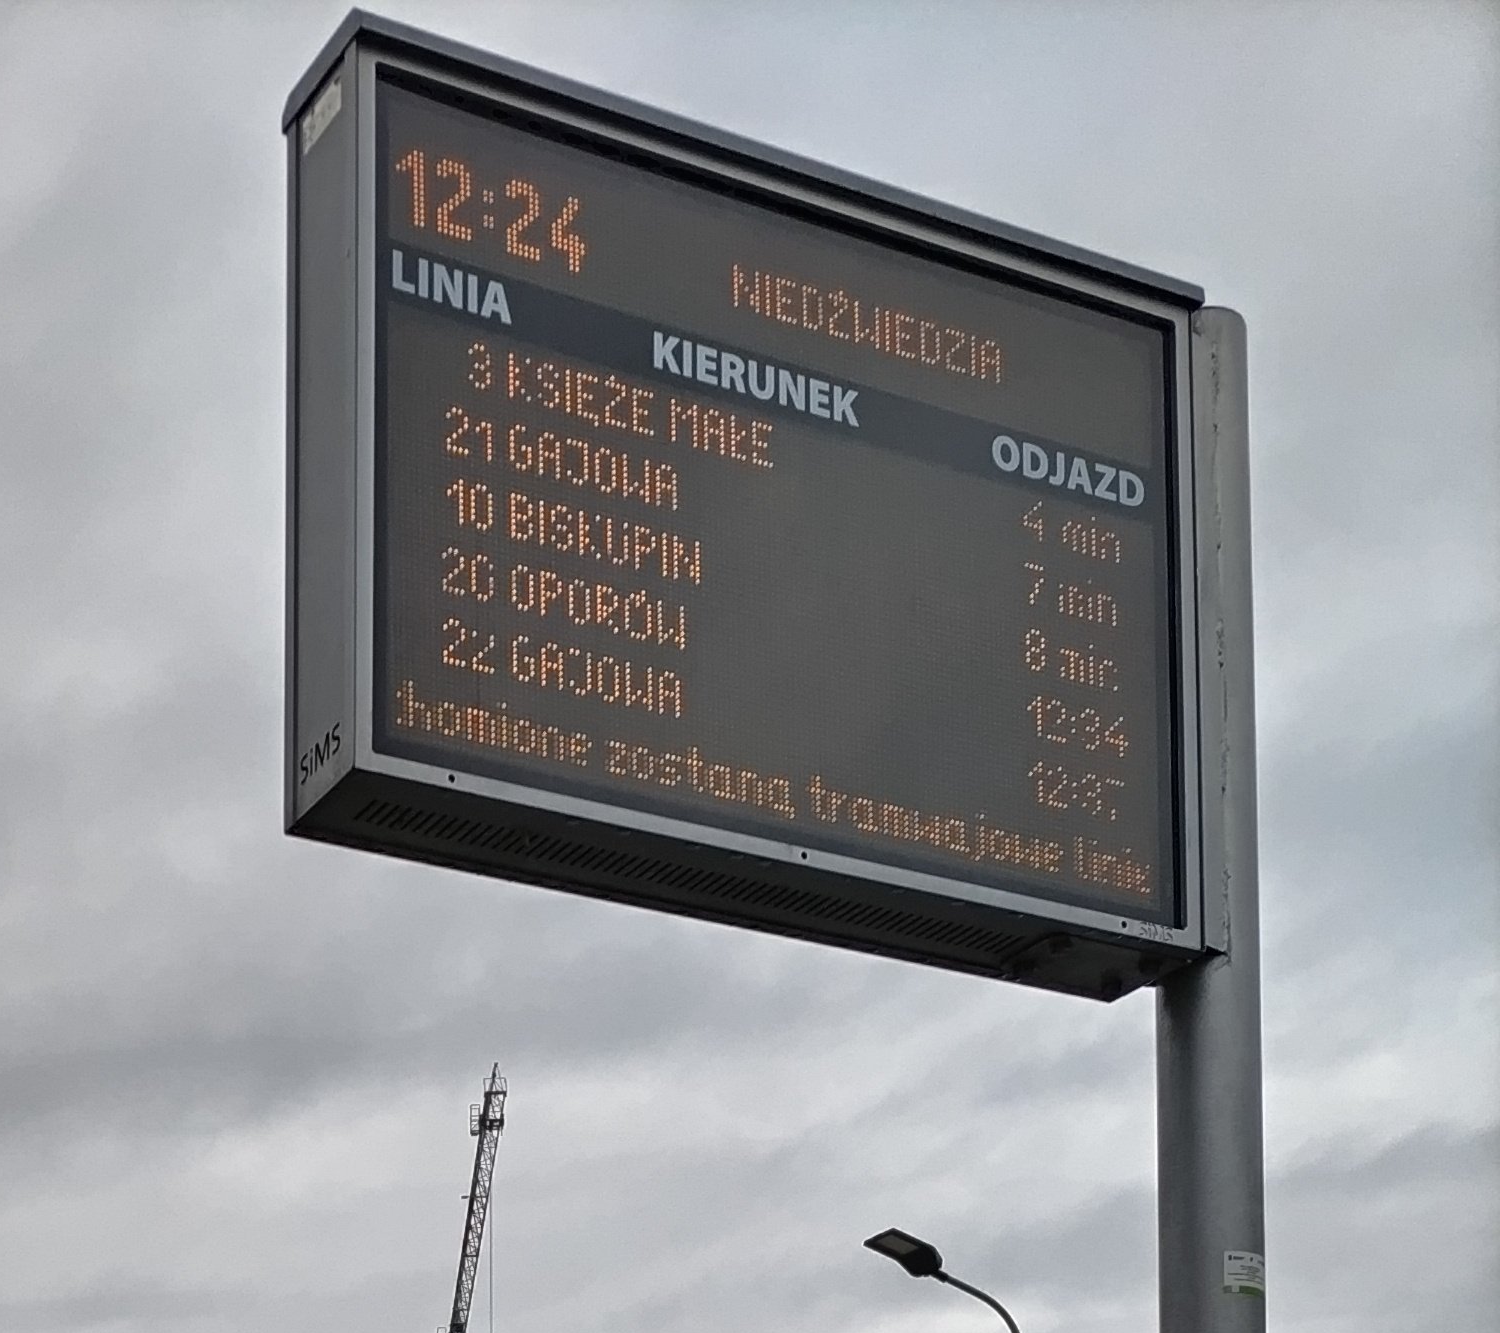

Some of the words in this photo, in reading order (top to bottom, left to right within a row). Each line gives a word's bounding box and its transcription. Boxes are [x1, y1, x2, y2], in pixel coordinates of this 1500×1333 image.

[396, 150, 586, 273] 12:24
[392, 249, 512, 325] LINIA
[468, 342, 491, 390] 3
[653, 330, 860, 428] KIERUNEK
[445, 406, 493, 463] 21
[508, 424, 678, 511] GAJOWA
[992, 435, 1145, 507] ODJAZD
[446, 478, 493, 531] 10
[510, 492, 700, 585] BISKUPIN
[1022, 501, 1044, 541] 4
[1062, 515, 1121, 563] min
[442, 546, 494, 602] 20
[511, 563, 685, 650] OPORÓW
[1024, 562, 1044, 605] 7
[442, 618, 495, 674] 22
[512, 635, 681, 718] GAJOWA
[1025, 629, 1046, 671] 8
[396, 680, 593, 767] homione
[1027, 696, 1128, 757] 12:34
